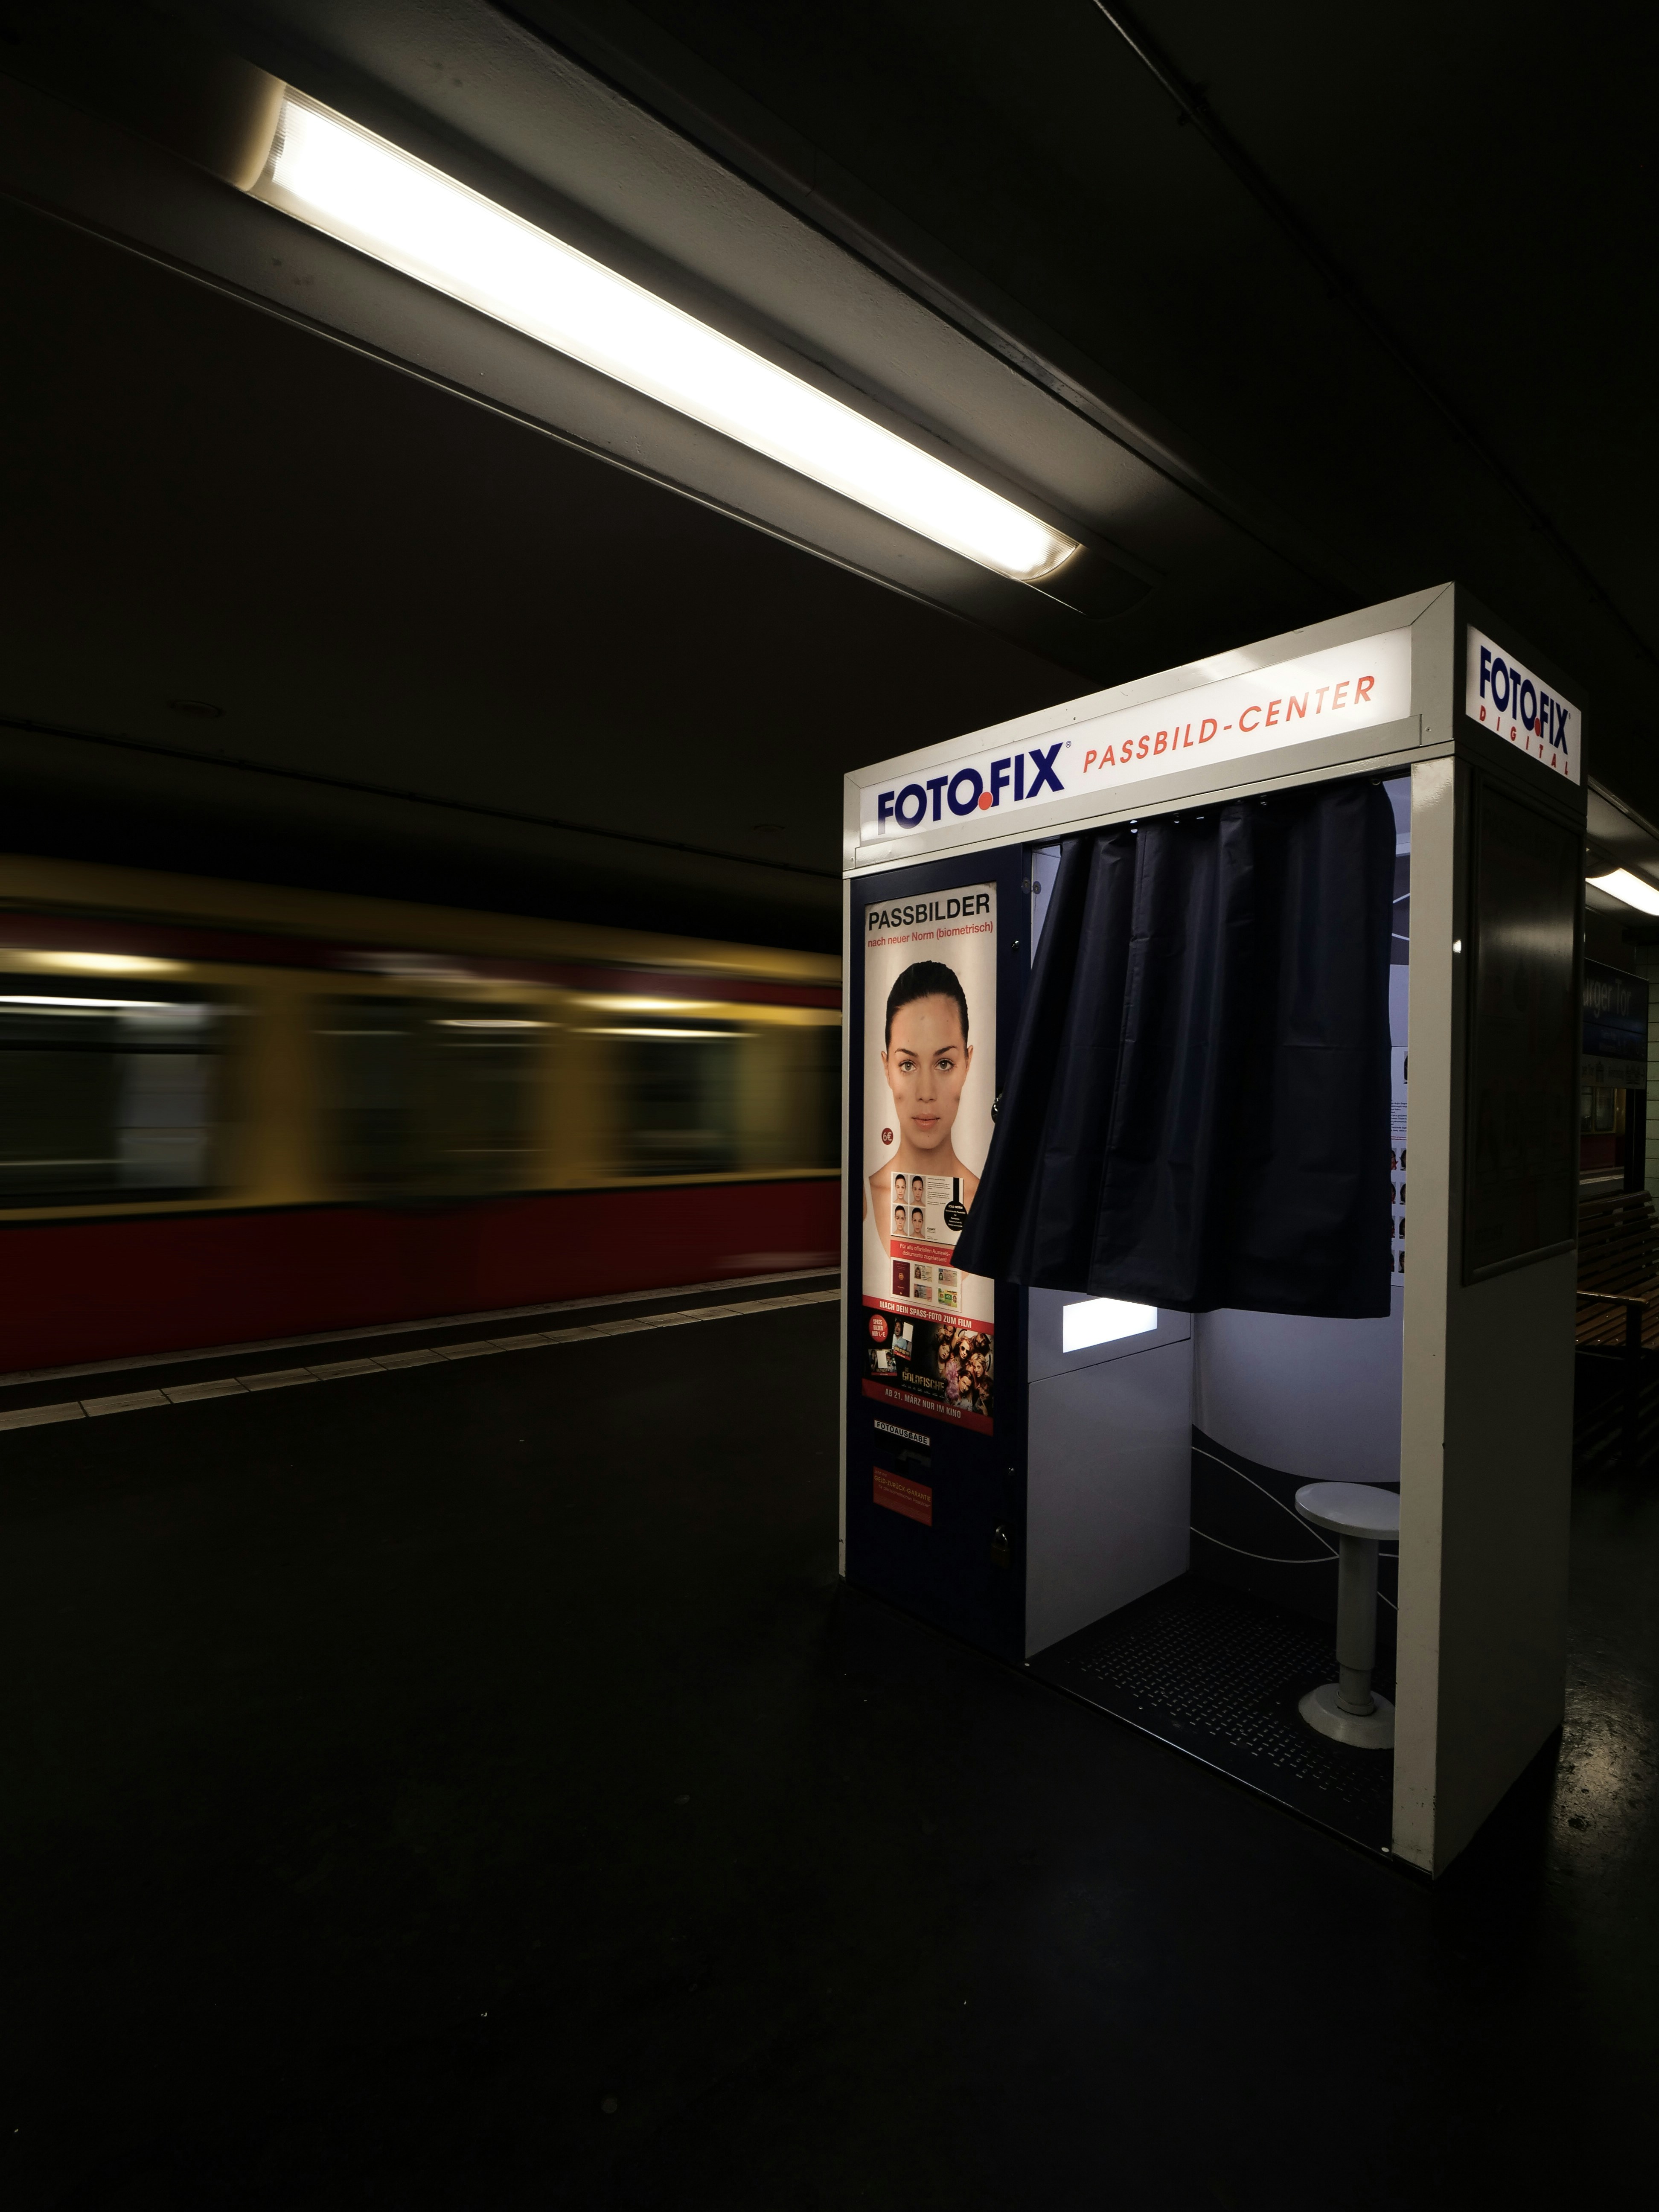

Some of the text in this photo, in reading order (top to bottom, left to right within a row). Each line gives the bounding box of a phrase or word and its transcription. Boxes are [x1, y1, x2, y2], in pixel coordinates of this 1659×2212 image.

[1083, 675, 1375, 774] PASSBILD-CENTER
[1479, 705, 1568, 775] DIGITAL
[869, 893, 990, 931] PASSBILDER
[868, 921, 993, 947] nach neuer Norm (biometrisch)
[1615, 978, 1632, 1017] Tor
[882, 1131, 892, 1141] 6€
[902, 1250, 947, 1263] dokumente zugelassen!
[879, 1301, 972, 1329] MACH DEIN SPASS-FOTO ZUM FILM
[902, 1371, 944, 1391] GOLDFISCHE
[885, 1388, 893, 1397] AB
[894, 1391, 903, 1401] 21.
[904, 1394, 921, 1406] MÄRZ
[923, 1401, 934, 1410] NUR
[936, 1404, 944, 1413] IM
[946, 1406, 961, 1418] KINO
[877, 1421, 928, 1444] FOTOAUSGABE
[874, 1475, 931, 1502] GELD-ZURÜCK-GARANTIE
